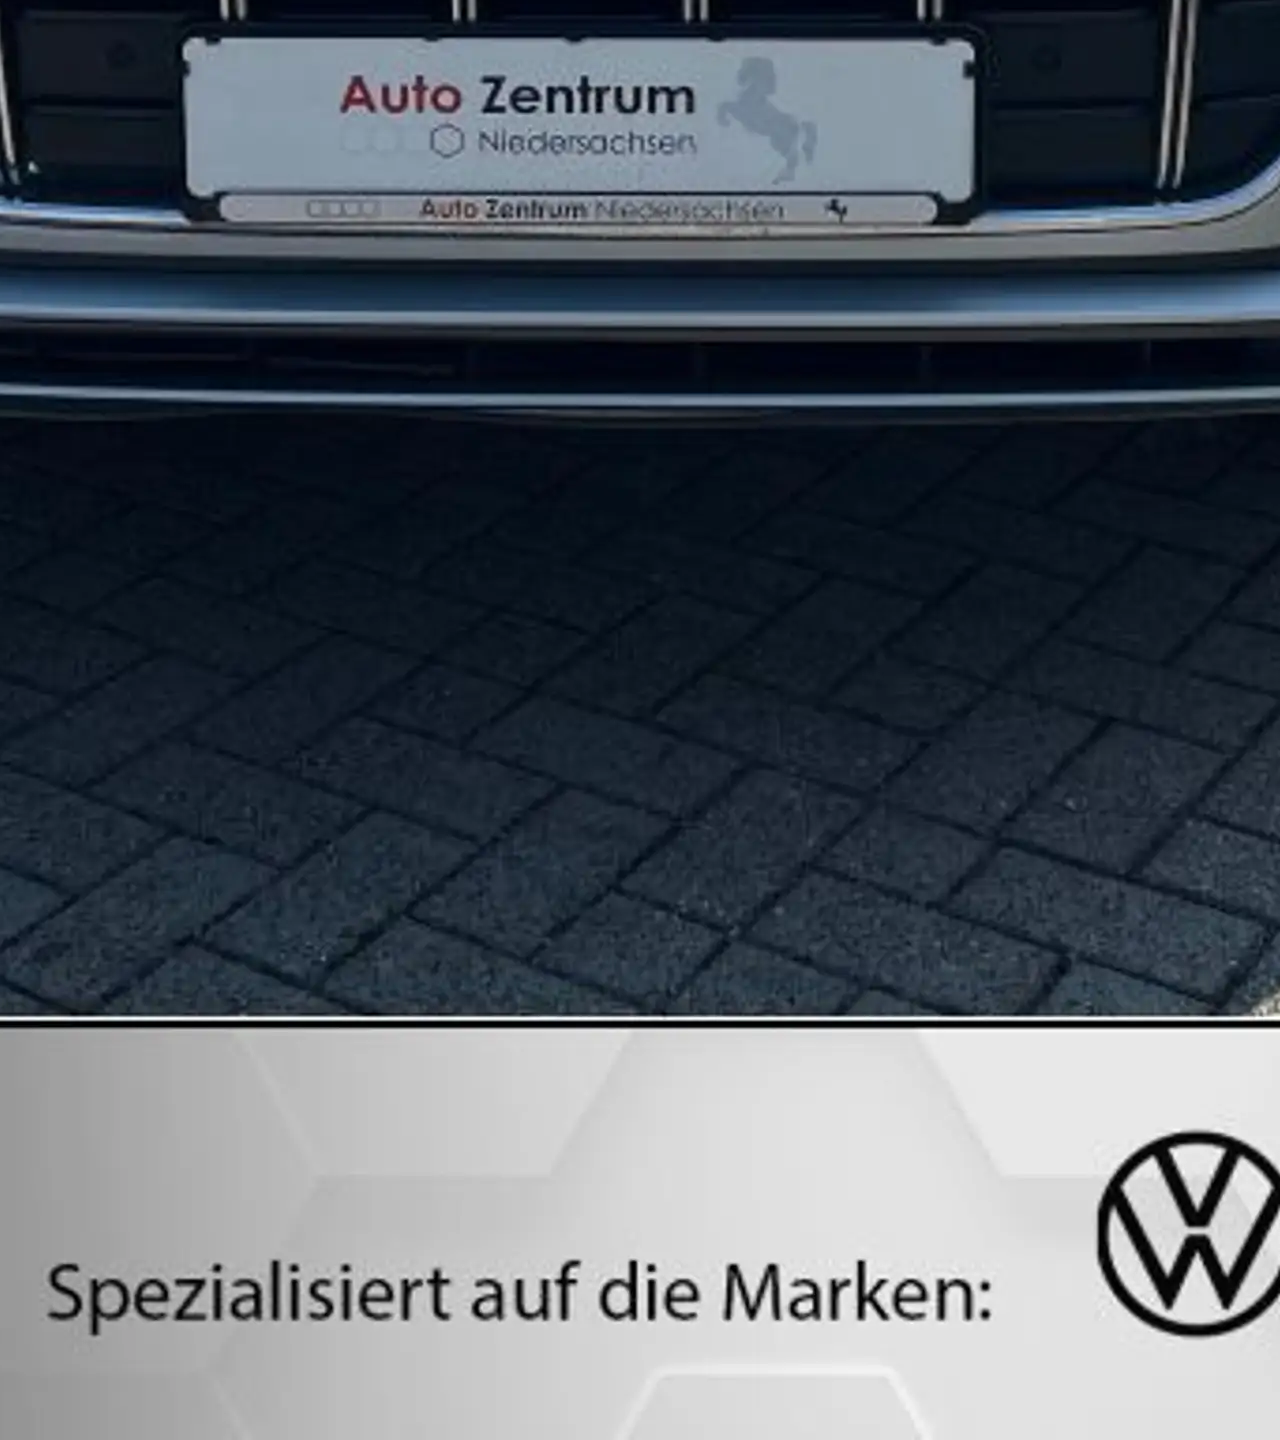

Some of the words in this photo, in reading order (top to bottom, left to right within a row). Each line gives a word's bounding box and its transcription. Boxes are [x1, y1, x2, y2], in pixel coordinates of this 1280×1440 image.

[339, 74, 463, 114] Auto
[480, 75, 695, 114] Zentrum
[478, 129, 697, 156] Niedersachsen
[419, 199, 479, 220] Auto
[485, 200, 587, 221] Zentrum
[593, 199, 786, 222] Niedersachsen
